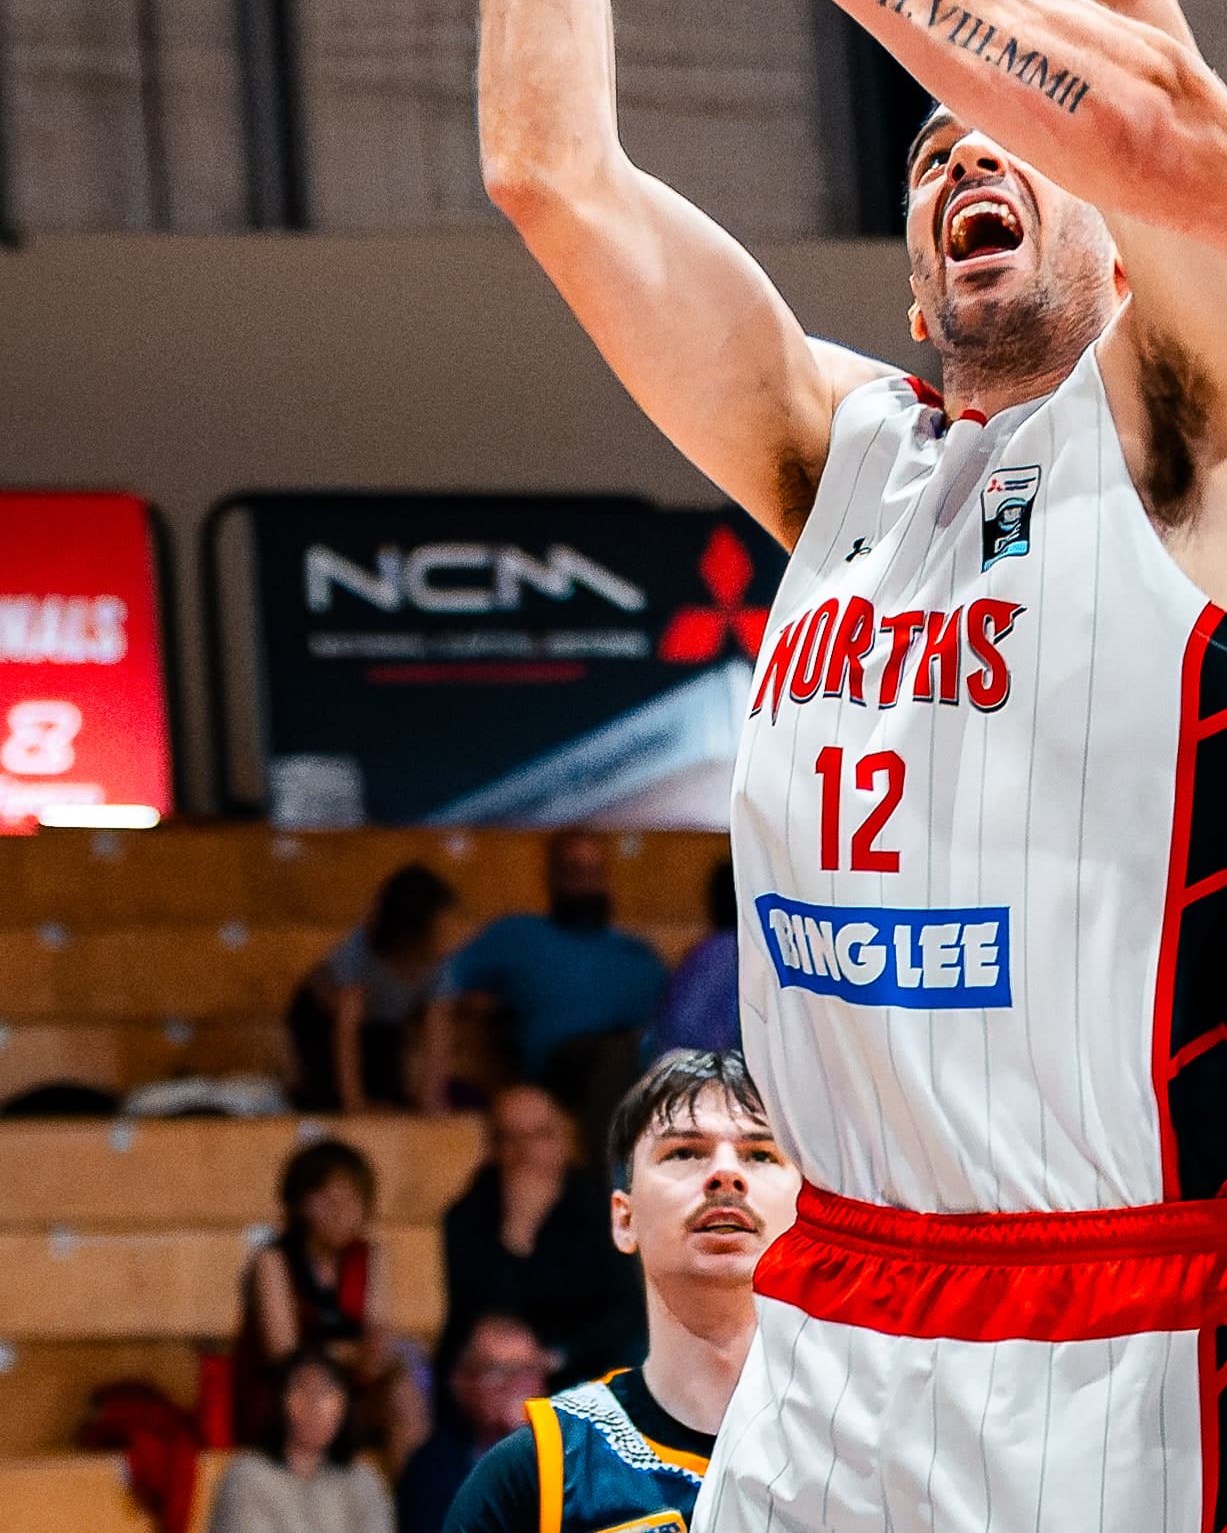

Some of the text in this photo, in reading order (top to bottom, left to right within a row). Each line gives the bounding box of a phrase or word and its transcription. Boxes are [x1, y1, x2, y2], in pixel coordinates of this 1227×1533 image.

[304, 543, 646, 611] NCM
[749, 595, 1027, 727] NORTHS
[815, 746, 906, 873] 12
[769, 909, 1000, 989] BING LEE
